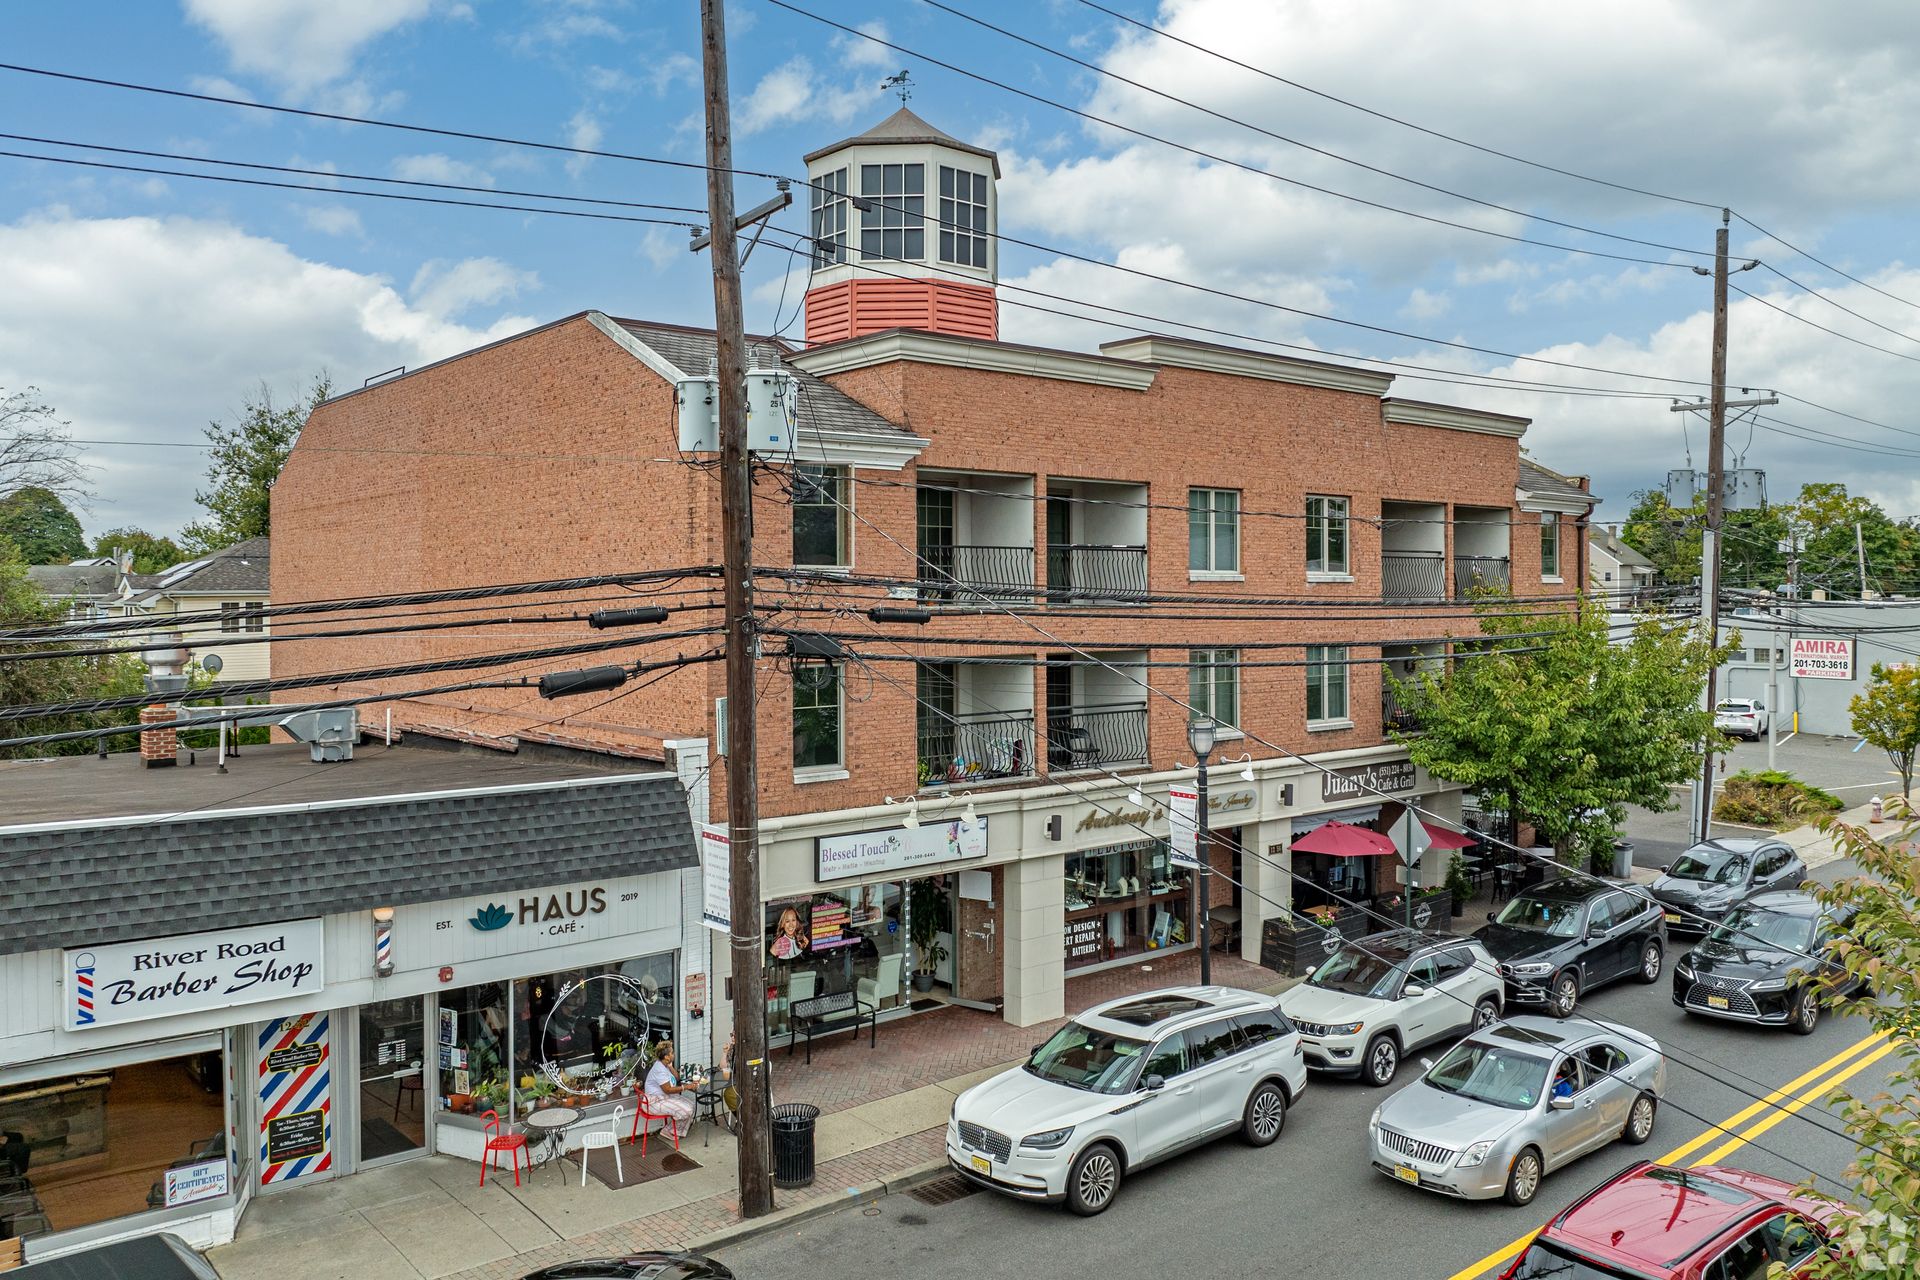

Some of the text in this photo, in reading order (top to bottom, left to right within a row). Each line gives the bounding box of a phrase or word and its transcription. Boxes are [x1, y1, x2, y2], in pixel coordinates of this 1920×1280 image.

[1794, 640, 1848, 654] AMIRA
[1794, 660, 1848, 669] 201-703-3618
[1379, 766, 1391, 776] (551)
[1324, 766, 1377, 796] Juany's
[1377, 774, 1415, 791] Cafe & Grill
[822, 844, 857, 863] Blessed
[860, 842, 889, 857] Touch
[621, 892, 638, 902] 2019
[518, 887, 606, 925] HAUS
[436, 920, 453, 930] EST.
[549, 920, 576, 936] CAFÉ
[1073, 921, 1095, 933] DESIGN
[1075, 931, 1095, 944] REPAIR
[133, 936, 285, 971] River Road
[1072, 943, 1096, 957] BATTERIES
[102, 958, 313, 1005] Barber Shop
[192, 1168, 208, 1177] GIFT
[177, 1174, 225, 1190] CERTIFICATES
